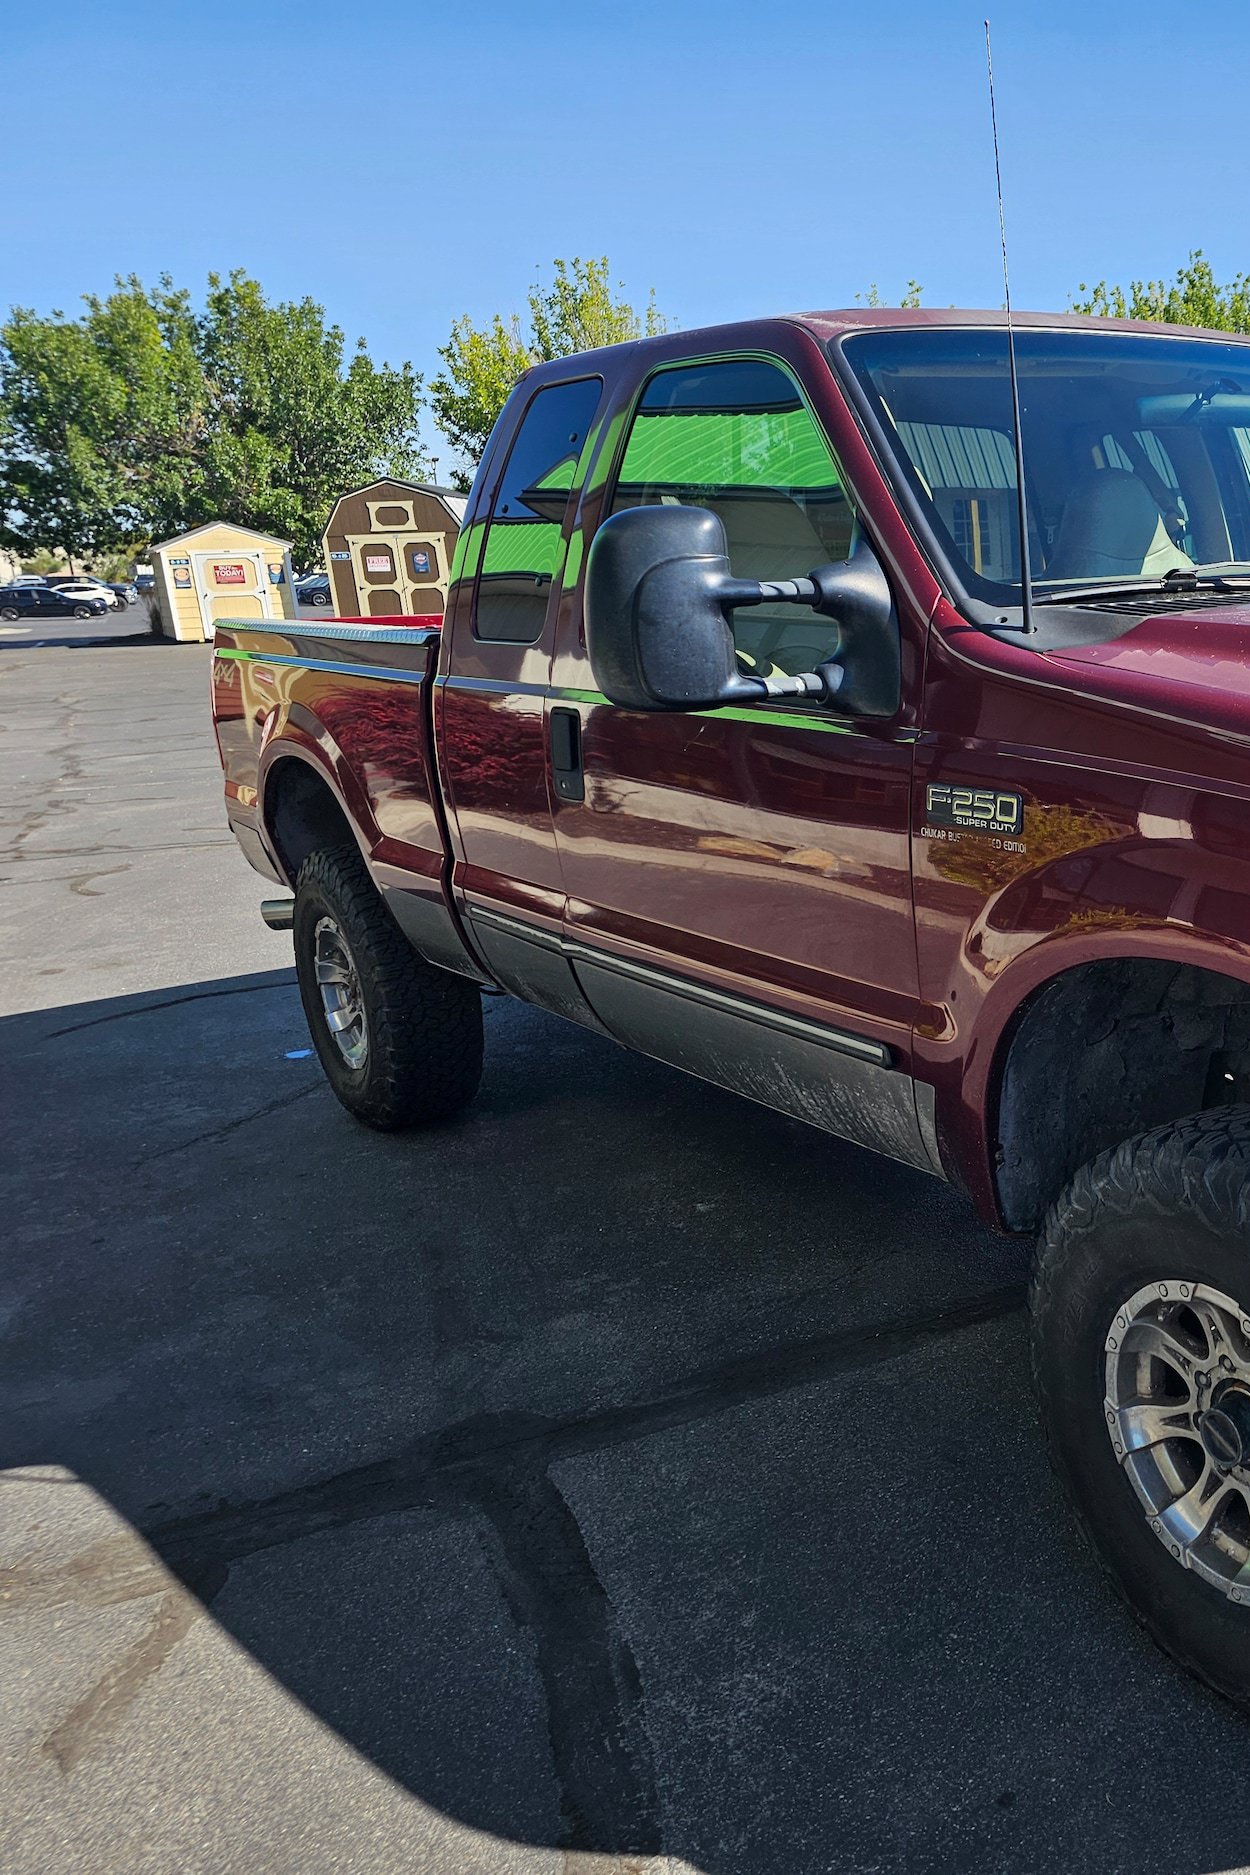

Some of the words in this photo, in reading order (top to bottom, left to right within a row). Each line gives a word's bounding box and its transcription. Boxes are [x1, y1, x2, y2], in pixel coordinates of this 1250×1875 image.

[955, 817, 988, 829] SUPER
[989, 822, 1017, 833] DUTY
[921, 827, 947, 840] CHUKAR
